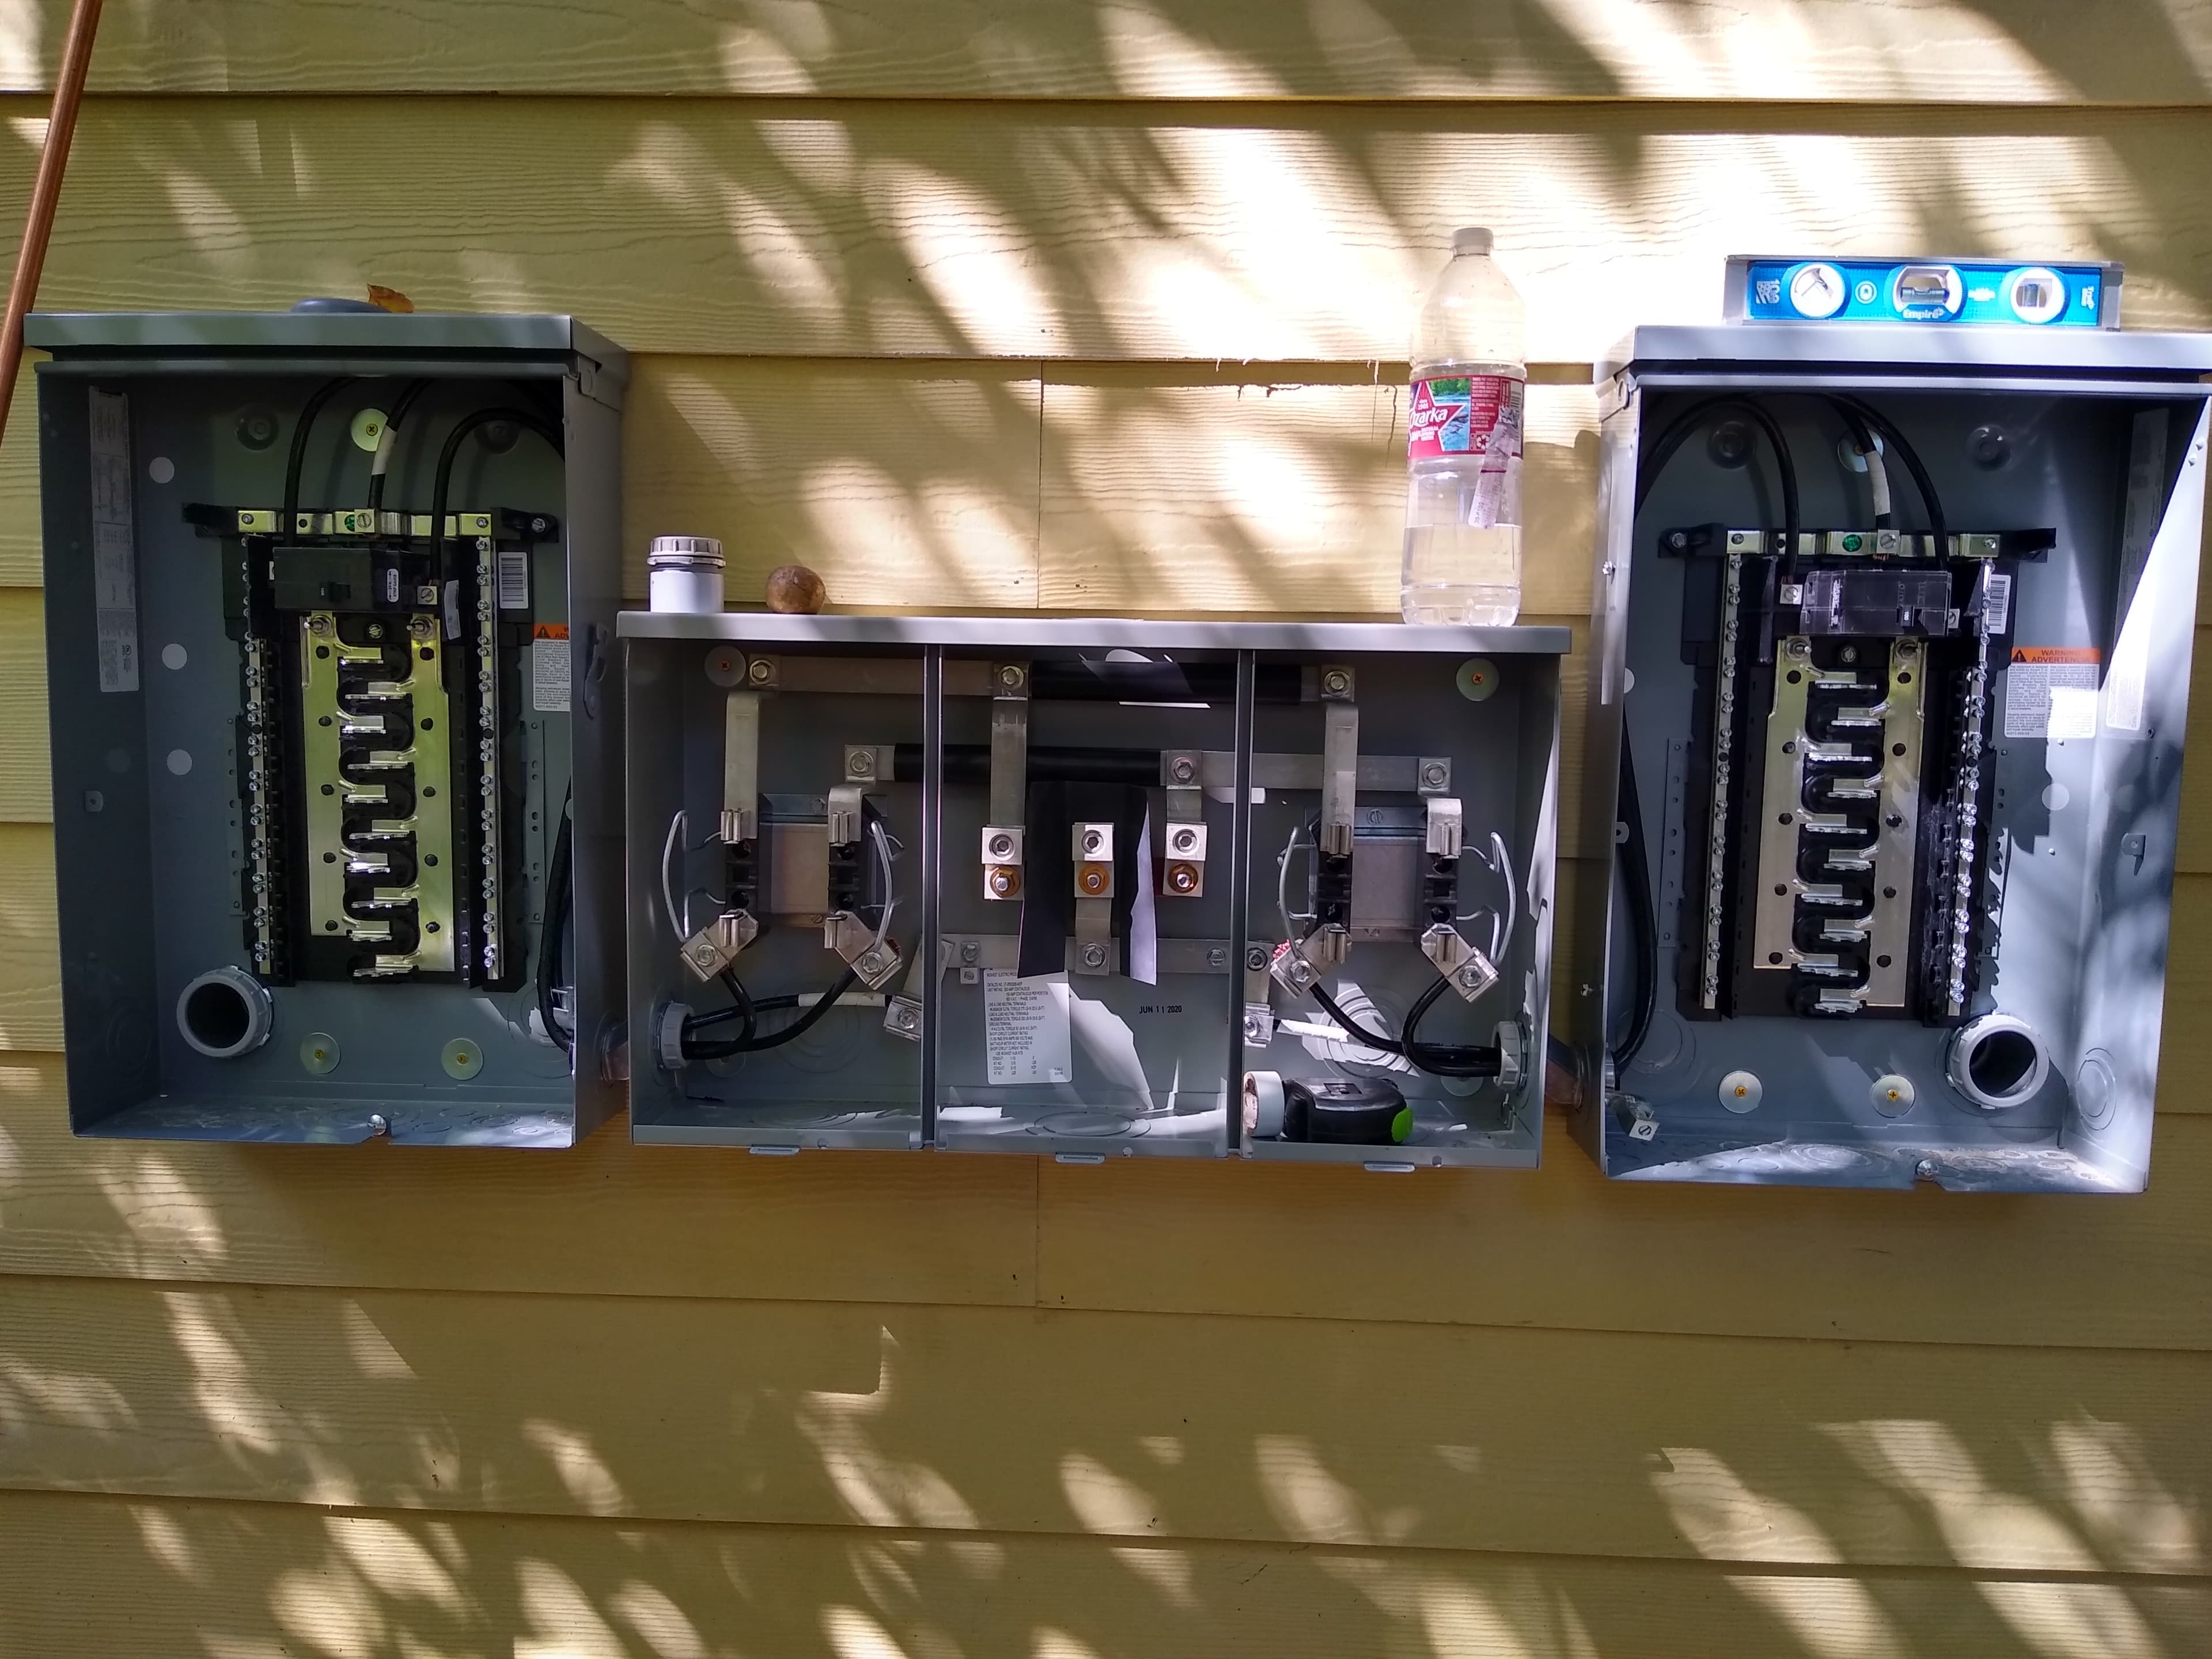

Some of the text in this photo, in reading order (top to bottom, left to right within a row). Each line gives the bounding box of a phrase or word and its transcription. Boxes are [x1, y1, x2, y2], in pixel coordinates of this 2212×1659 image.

[1903, 308, 1941, 320] Empire
[1410, 407, 1448, 429] Ozarka
[1139, 1005, 1153, 1014] JUN
[1167, 1005, 1182, 1013] 2020
